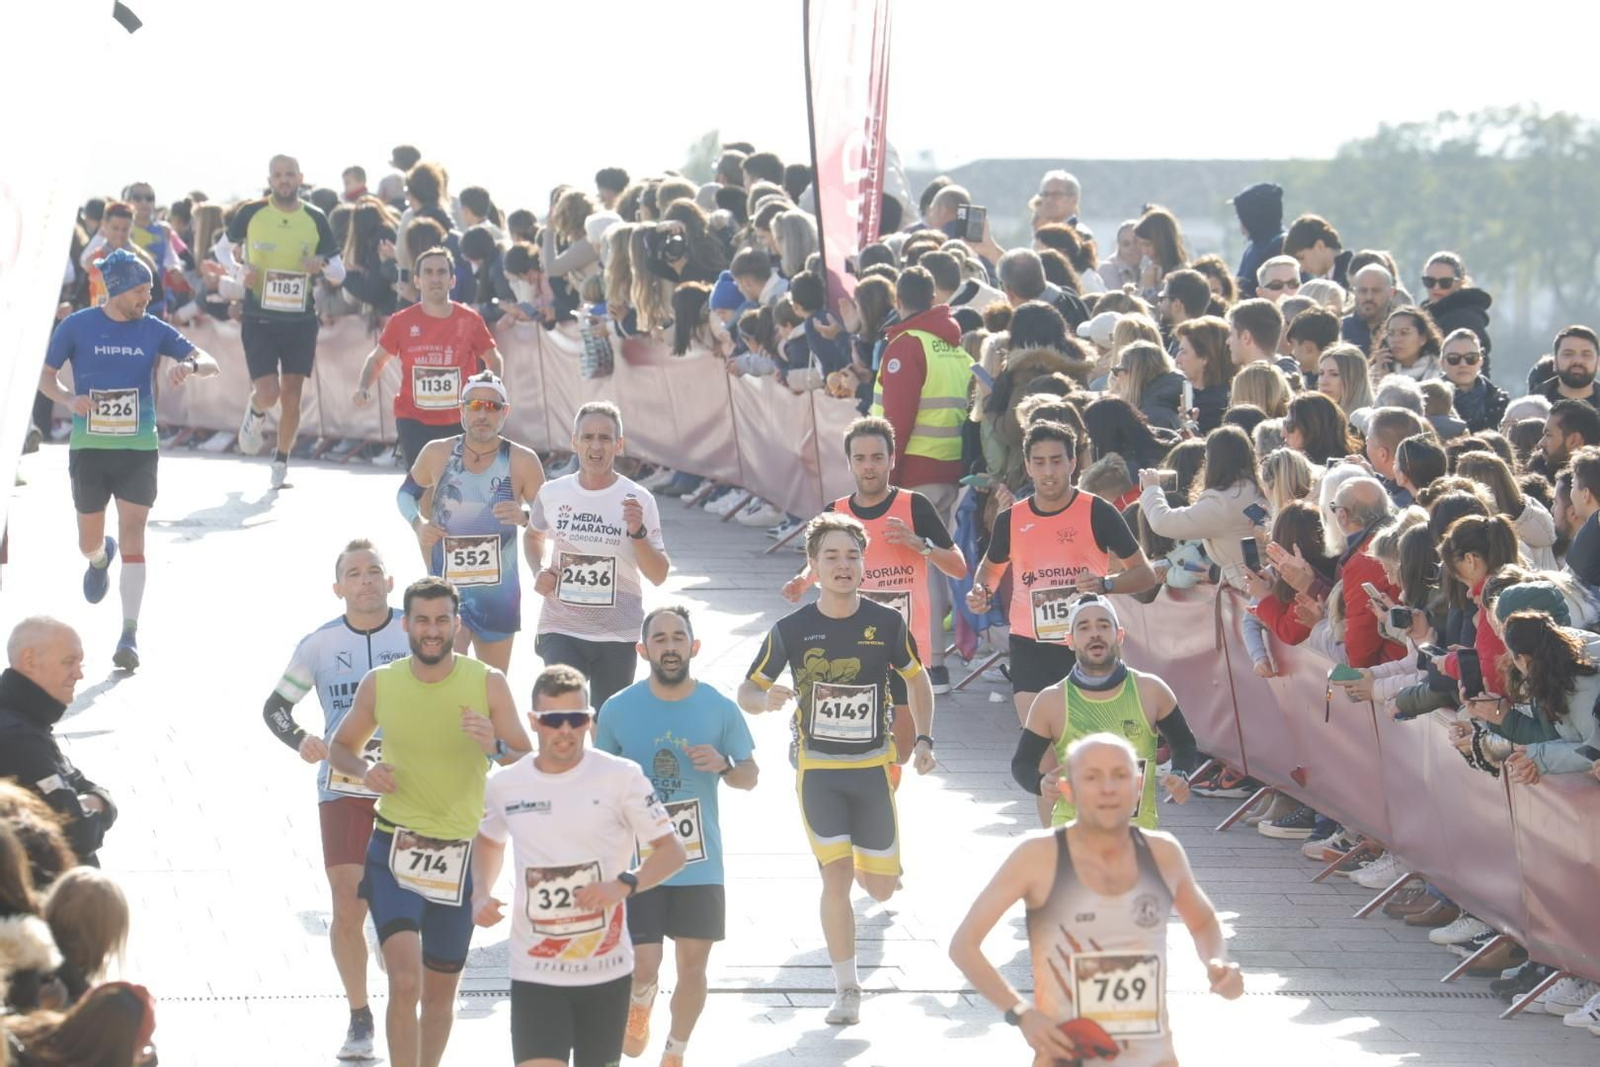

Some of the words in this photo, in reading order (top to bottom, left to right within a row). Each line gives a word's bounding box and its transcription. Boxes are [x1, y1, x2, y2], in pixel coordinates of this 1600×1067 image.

[272, 282, 300, 295] 1182
[94, 345, 144, 356] HIPRA
[421, 379, 452, 392] 1138
[572, 513, 603, 524] MEDIA
[556, 519, 570, 530] 37
[570, 522, 622, 536] MARATÓN
[454, 550, 490, 566] 552
[562, 568, 611, 587] 2436
[865, 565, 914, 579] SORIANO
[1037, 566, 1090, 578] SORIANO
[1050, 578, 1076, 586] MUEB
[820, 701, 869, 720] 4149
[409, 851, 448, 874] 714
[1093, 977, 1146, 1002] 769
